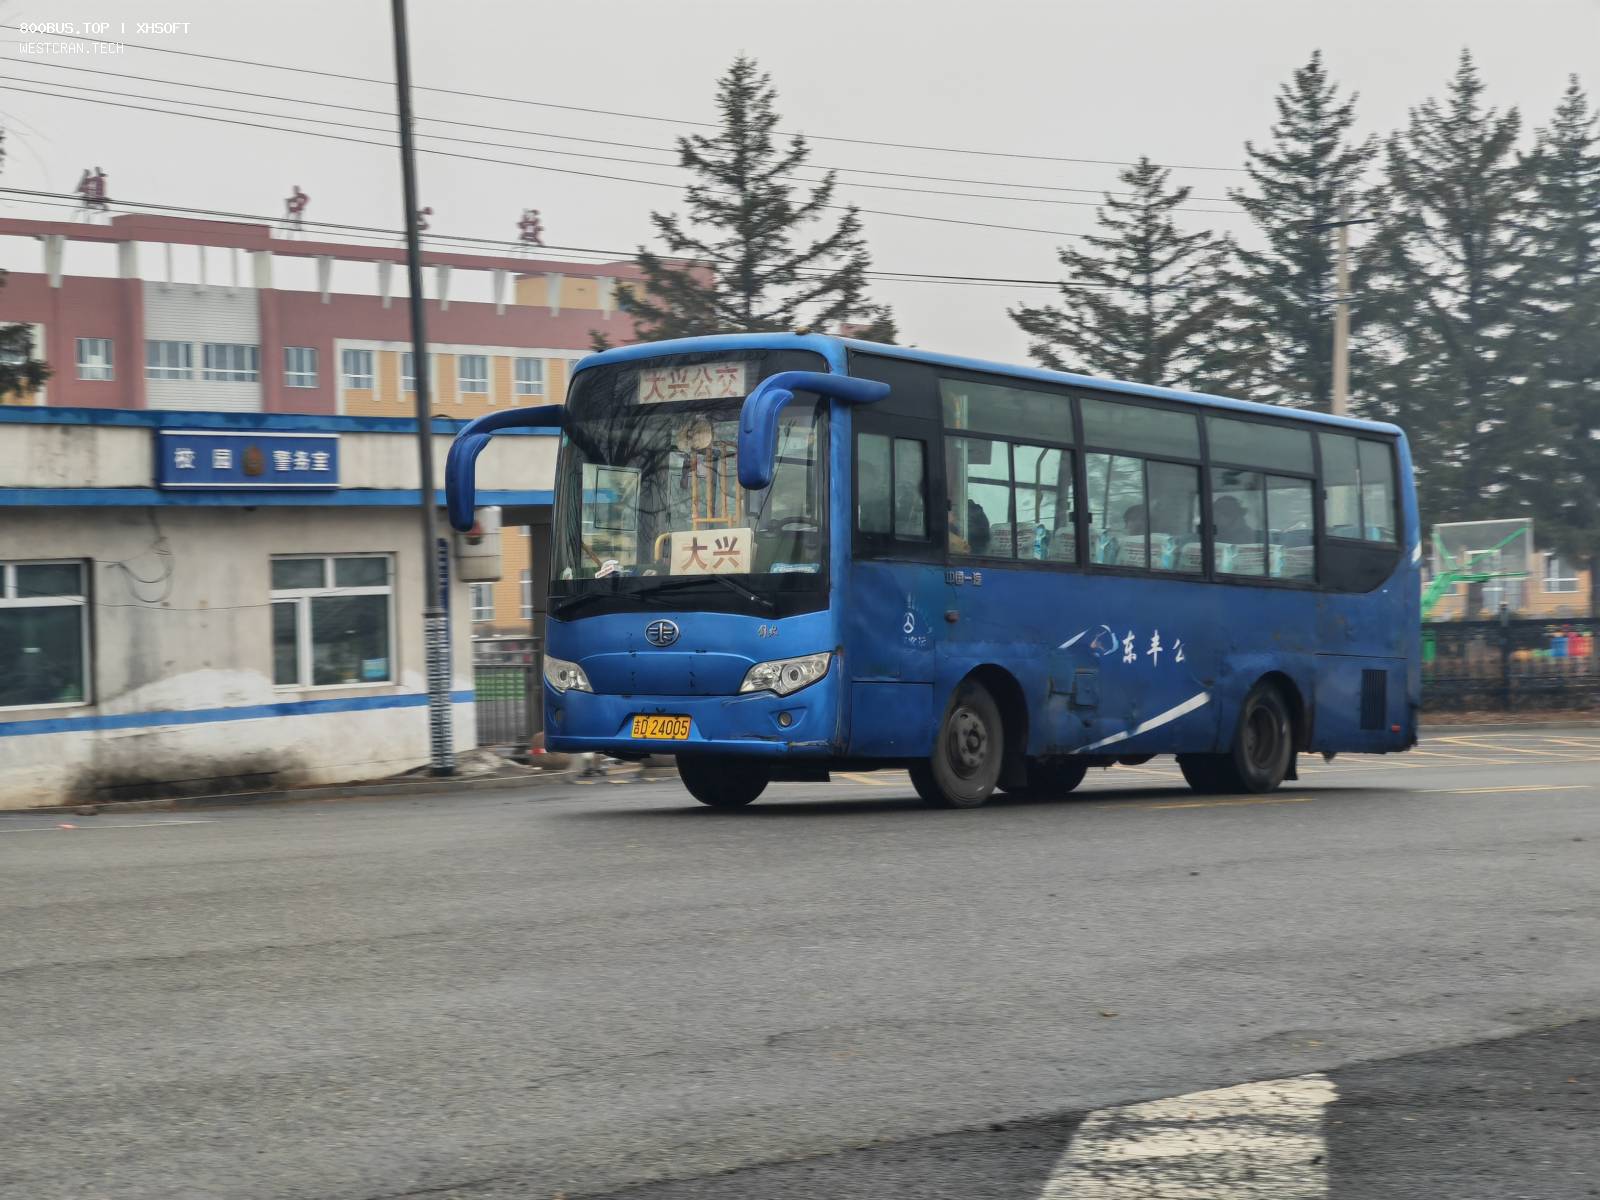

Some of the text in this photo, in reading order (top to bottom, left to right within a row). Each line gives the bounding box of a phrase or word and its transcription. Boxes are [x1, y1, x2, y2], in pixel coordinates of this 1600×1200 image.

[643, 365, 738, 401] 大兴公交
[681, 536, 741, 571] 大兴
